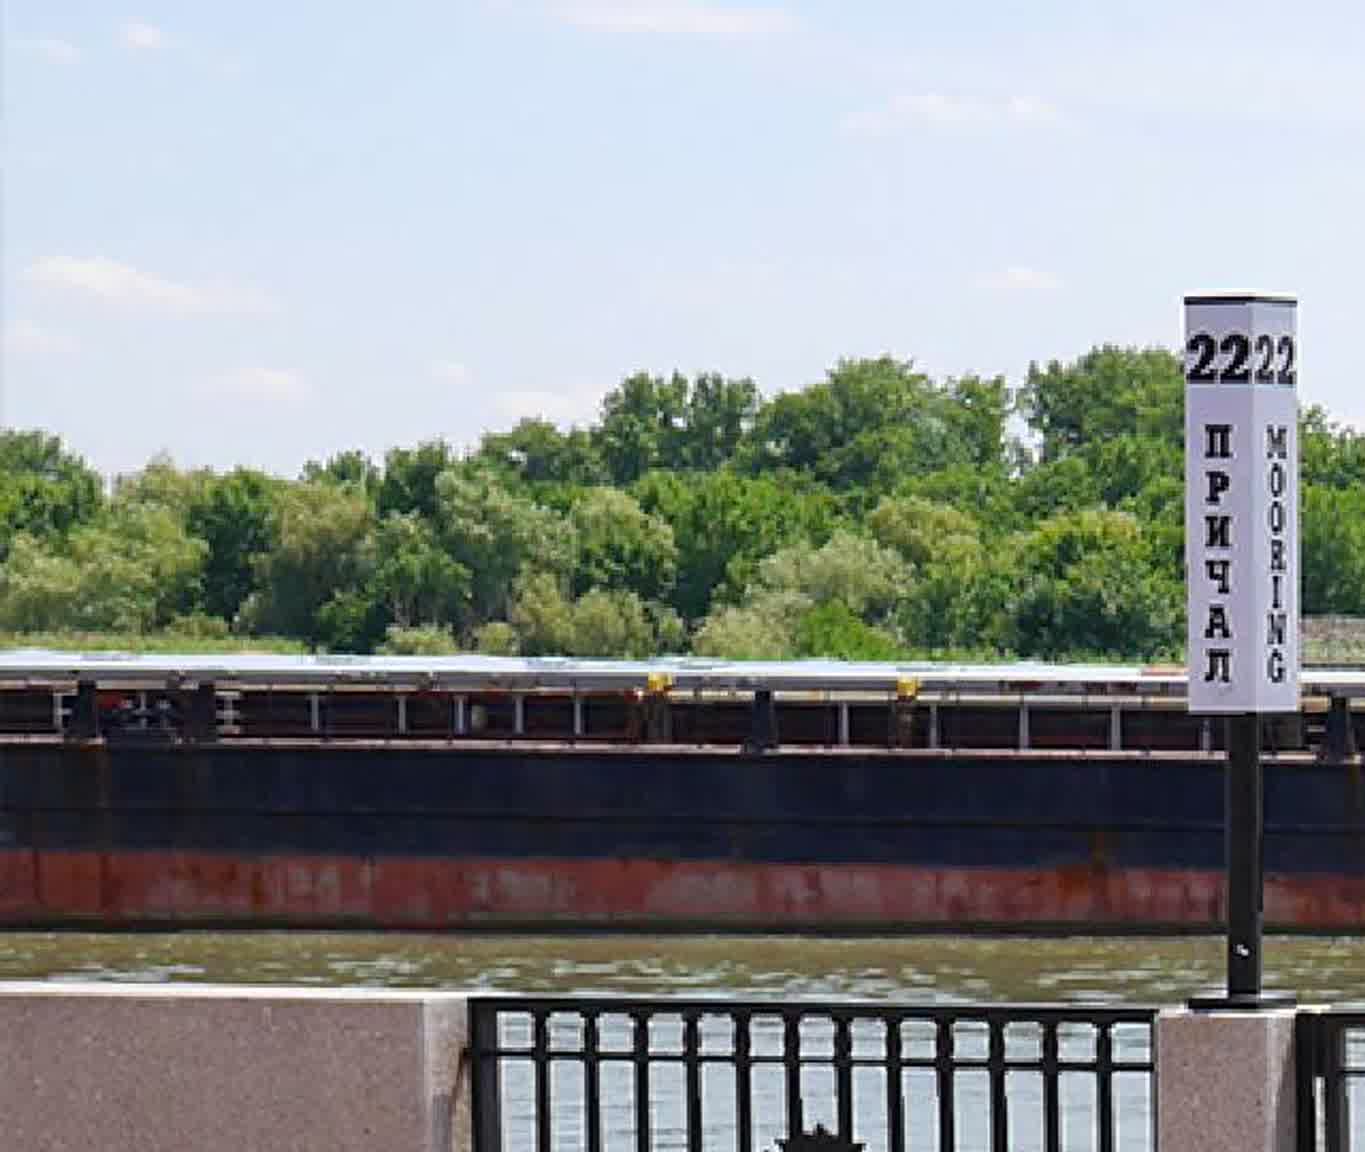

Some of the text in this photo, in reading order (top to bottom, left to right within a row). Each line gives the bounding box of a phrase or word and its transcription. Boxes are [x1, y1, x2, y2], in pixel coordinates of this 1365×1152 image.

[1185, 334, 1251, 385] 22
[1254, 334, 1297, 386] 22
[1204, 423, 1234, 684] ПРИЧАЛ
[1265, 424, 1288, 685] MOORING
